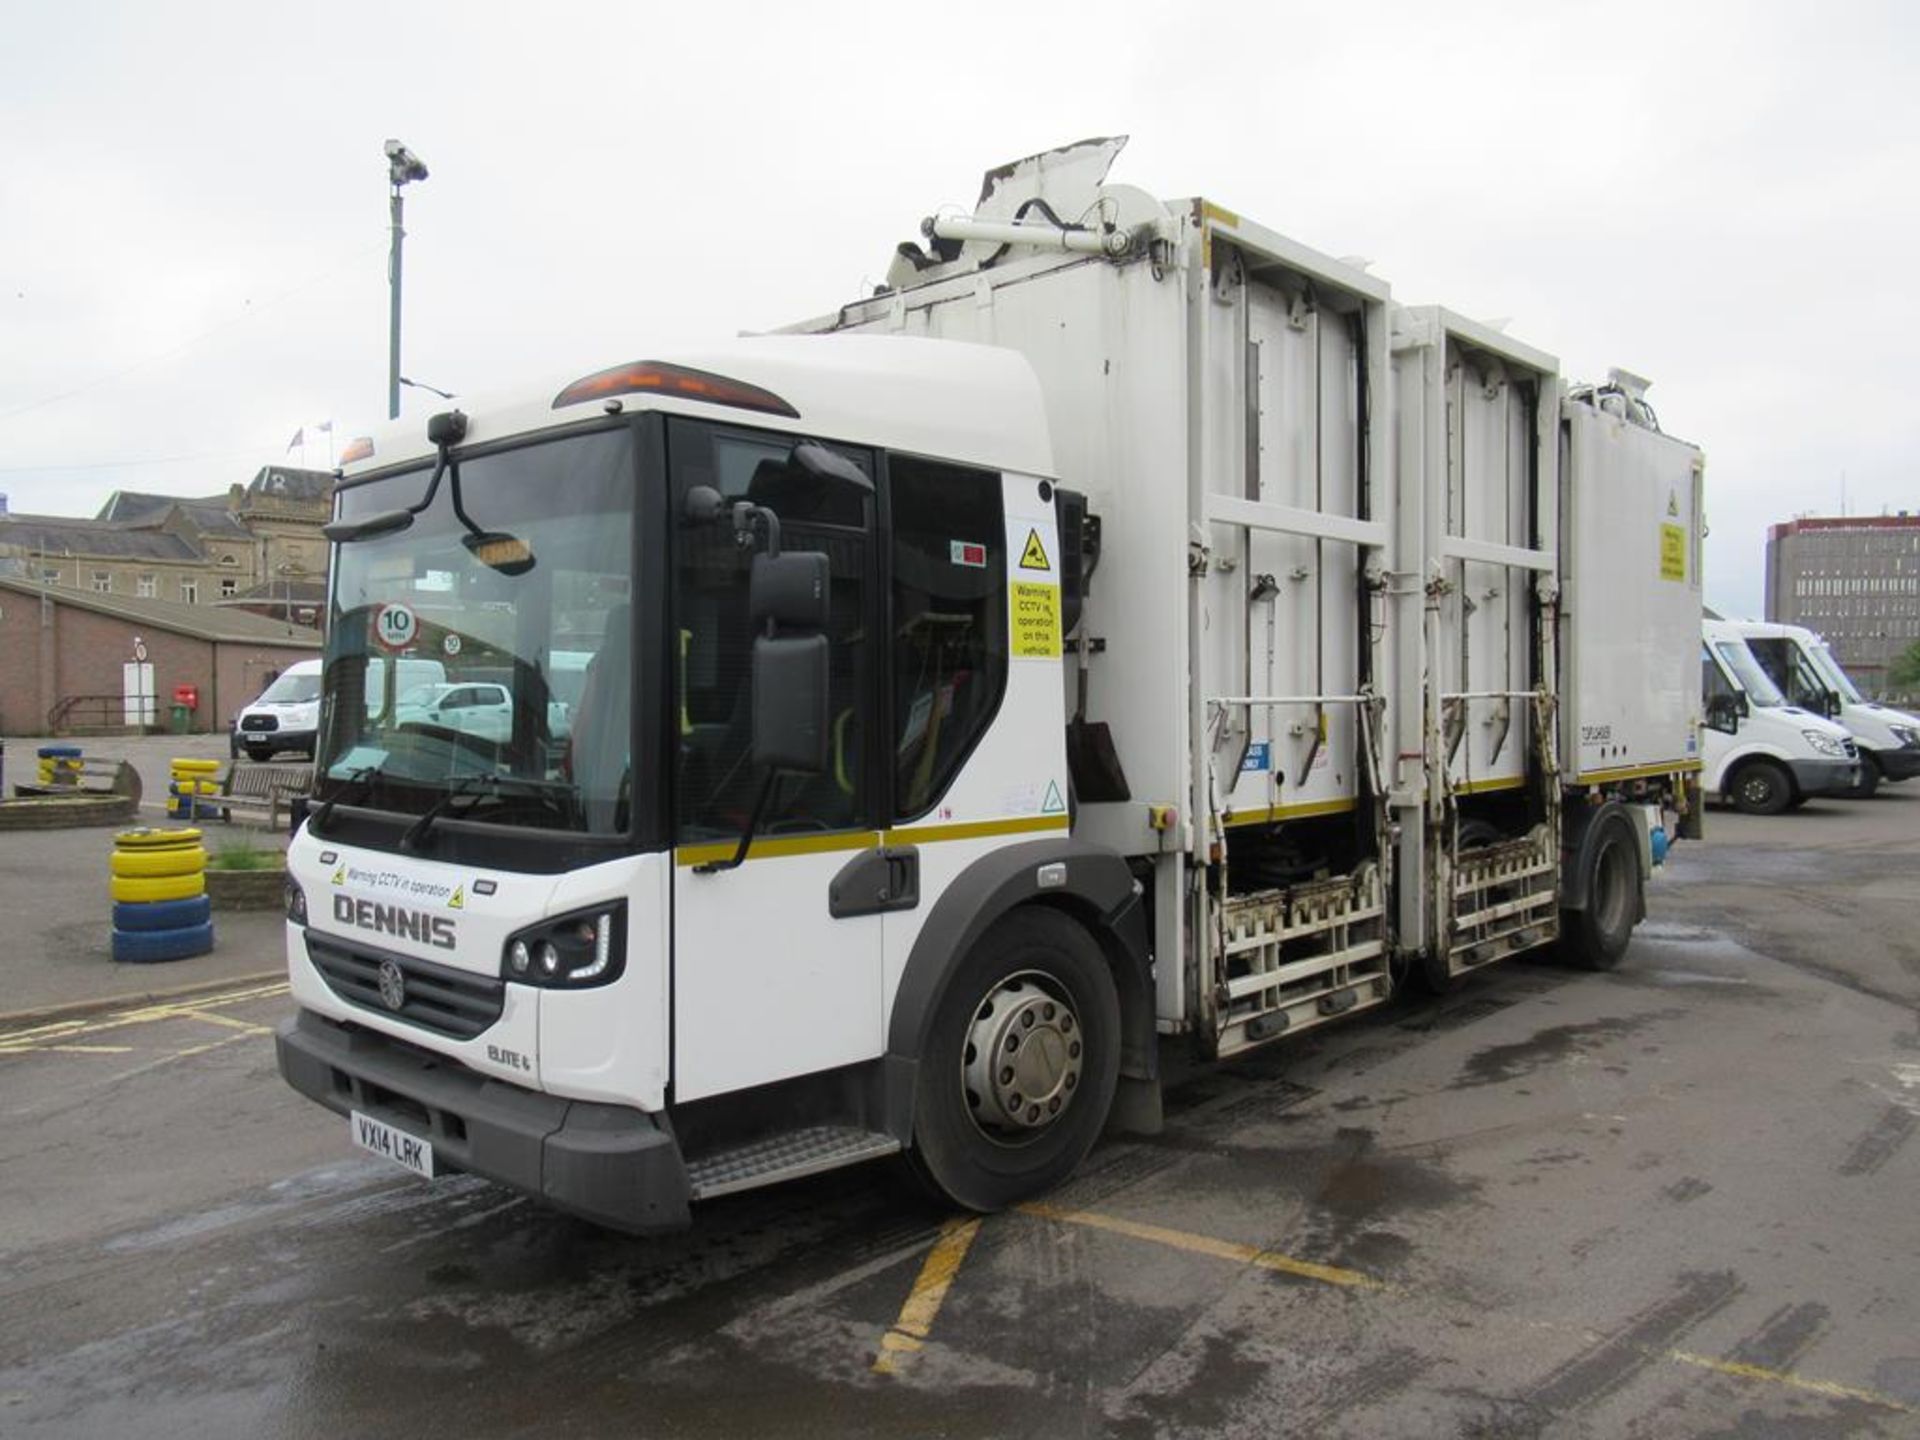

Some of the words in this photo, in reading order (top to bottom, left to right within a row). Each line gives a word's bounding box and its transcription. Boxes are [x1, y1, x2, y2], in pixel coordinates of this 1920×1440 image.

[1017, 585, 1051, 601] Warning
[1018, 600, 1041, 612] CCTV
[383, 610, 409, 630] 10
[1017, 617, 1054, 627] operation
[1023, 631, 1034, 641] on
[1034, 630, 1050, 641] this
[348, 867, 377, 887] Warning
[378, 872, 401, 889] CCTV
[410, 881, 451, 898] operation
[333, 893, 456, 950] DENNIS
[487, 1044, 521, 1069] ELITE
[359, 1118, 391, 1155] VX14
[393, 1132, 423, 1170] LRK
